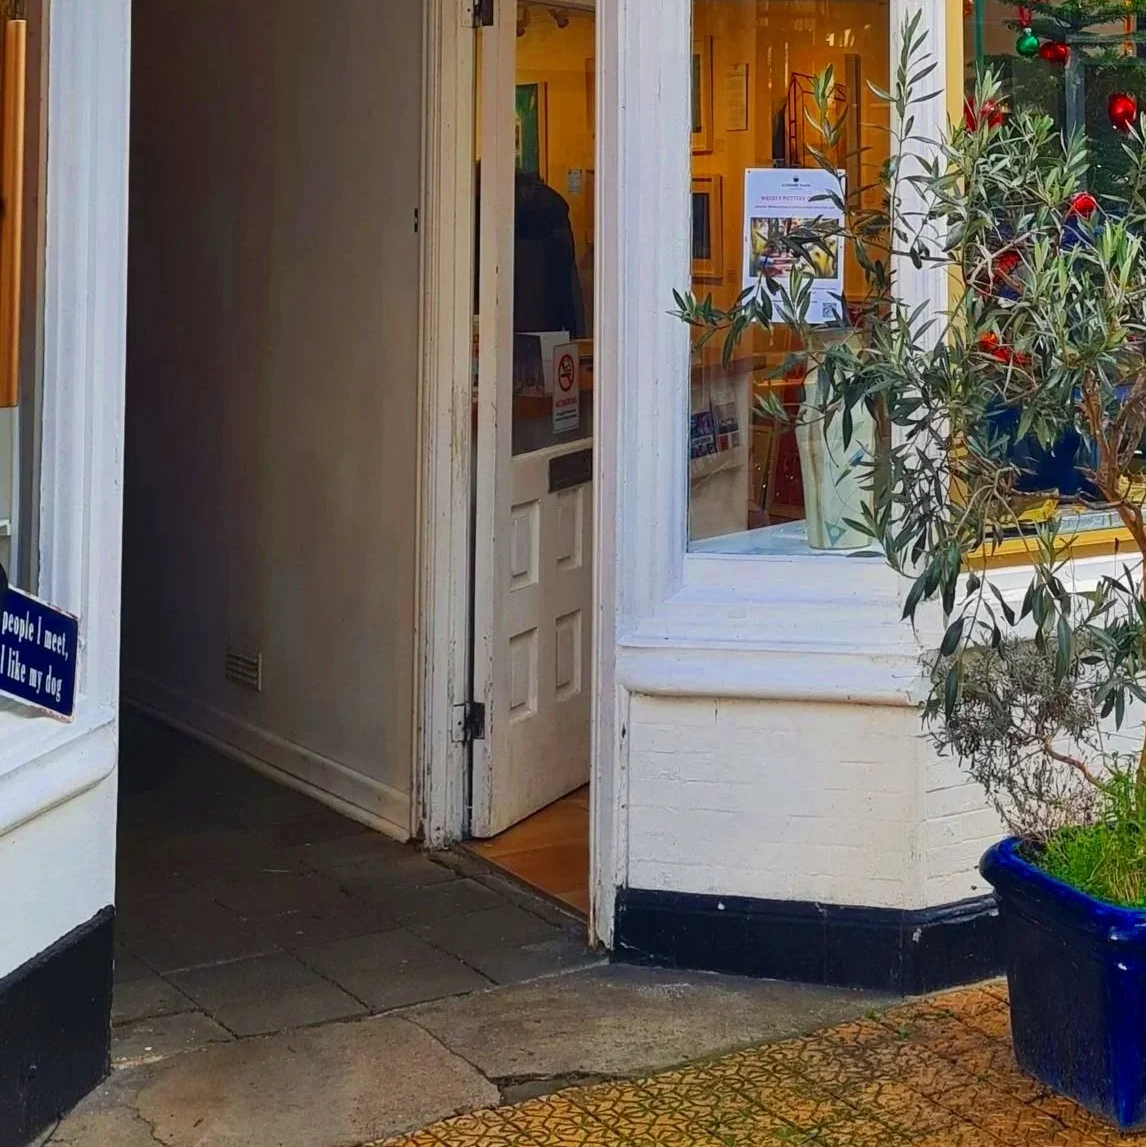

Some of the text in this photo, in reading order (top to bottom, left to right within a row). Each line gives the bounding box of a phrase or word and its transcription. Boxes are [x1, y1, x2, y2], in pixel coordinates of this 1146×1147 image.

[2, 610, 69, 661] people I meet,
[7, 647, 26, 682] like
[29, 667, 43, 694] my
[45, 665, 62, 702] dog
